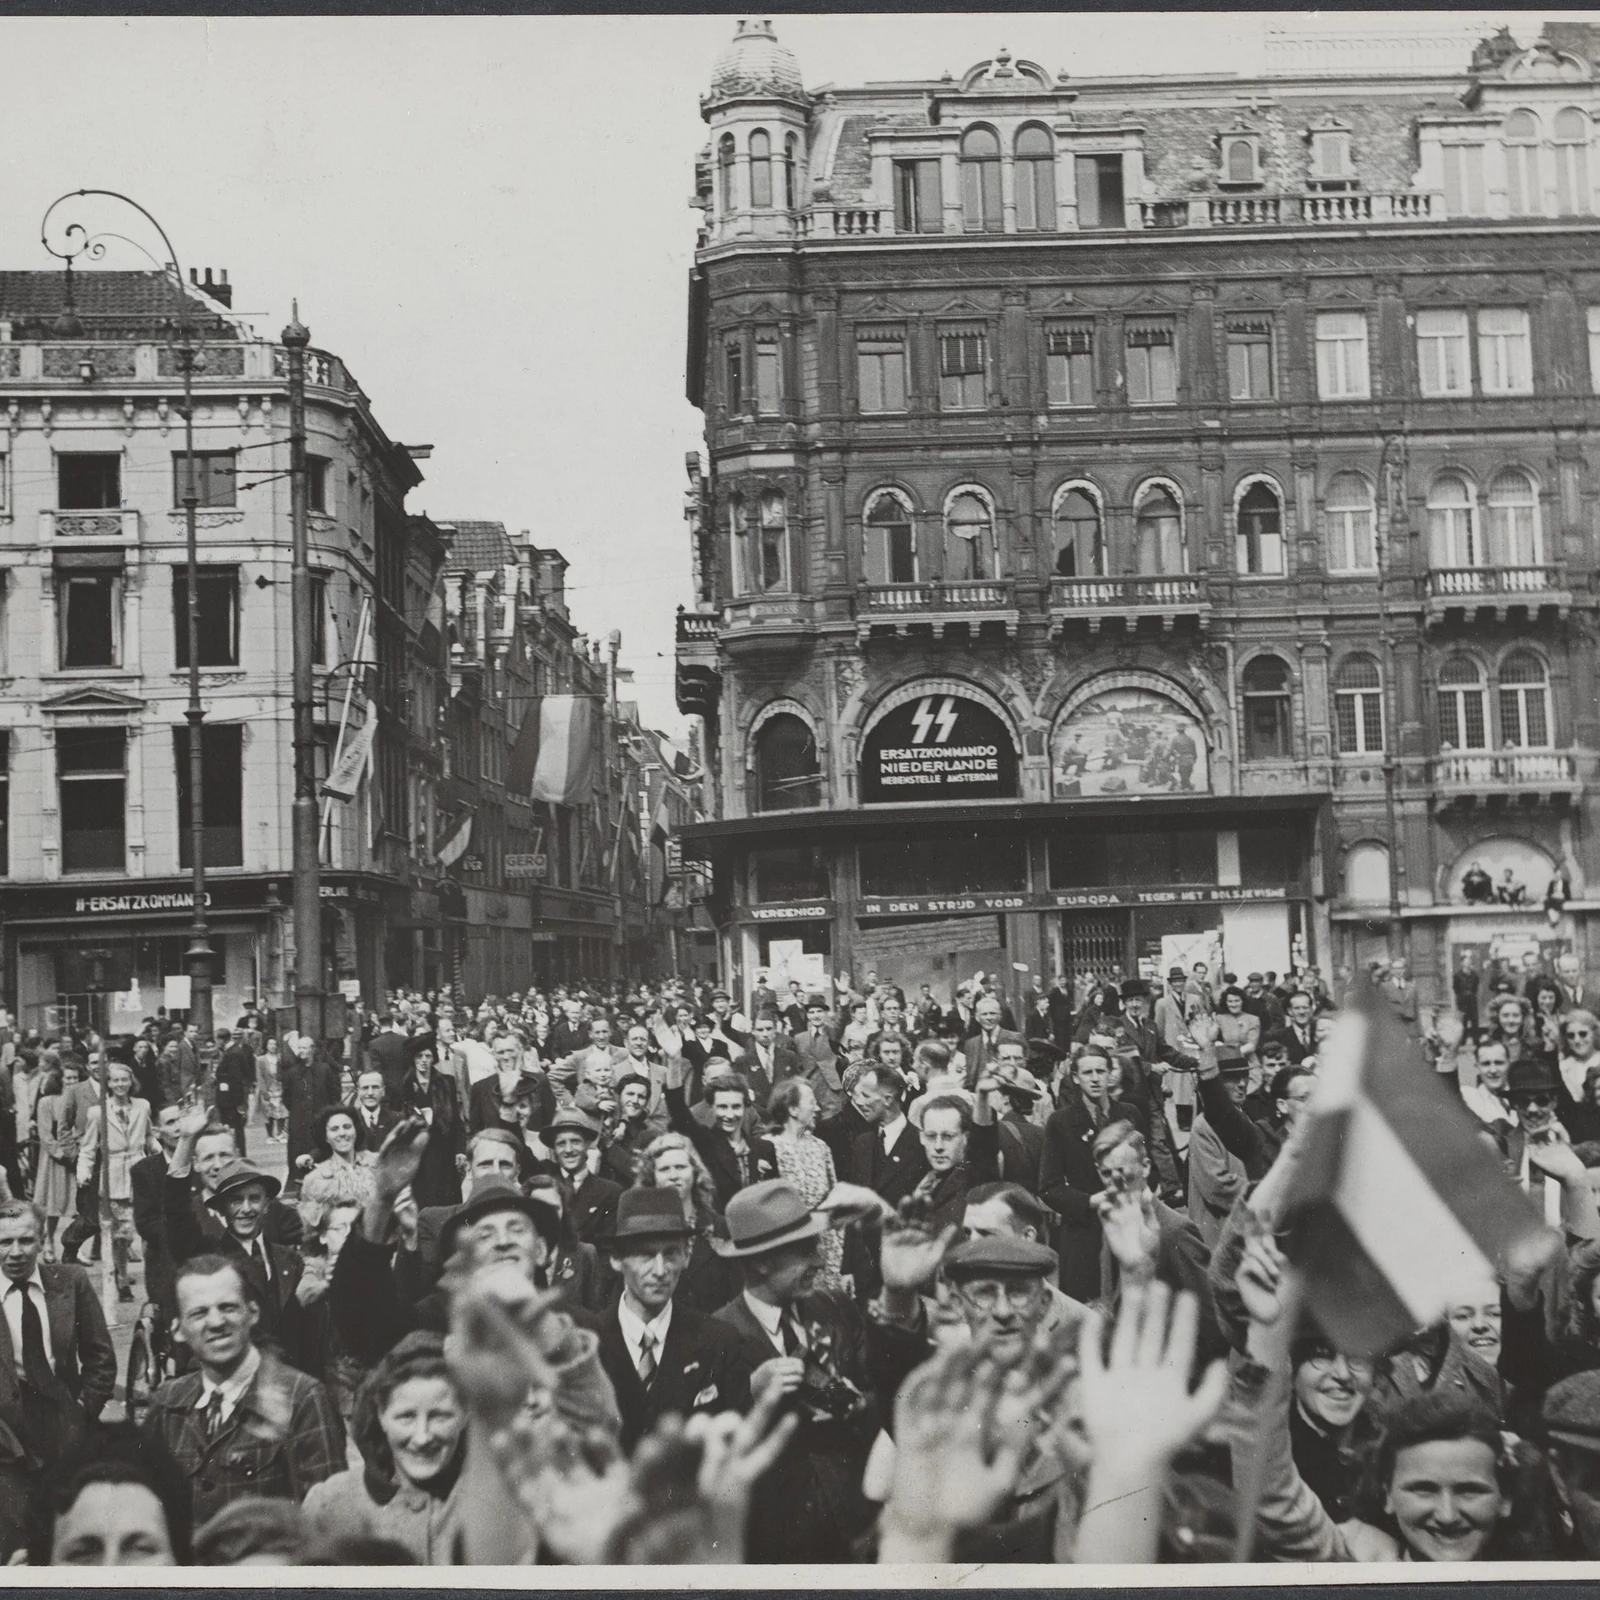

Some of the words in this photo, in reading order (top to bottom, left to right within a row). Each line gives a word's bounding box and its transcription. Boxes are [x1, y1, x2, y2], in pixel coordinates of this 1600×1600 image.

[880, 745, 998, 760] ERSATZKOMMANDO
[880, 759, 998, 774] NIEDERLANDE
[881, 775, 942, 785] NEBENSTELLE
[946, 773, 998, 782] AMSTERDAM
[507, 856, 545, 866] GERO
[751, 907, 826, 919] VEREENIGD
[866, 904, 881, 913] IN
[889, 902, 919, 912] DEN
[928, 900, 976, 910] STRIJD
[985, 898, 1024, 908] VOOR
[1138, 892, 1176, 902] TEGEN
[1181, 891, 1204, 900] HET
[1211, 888, 1286, 900] BOLSJEWISME
